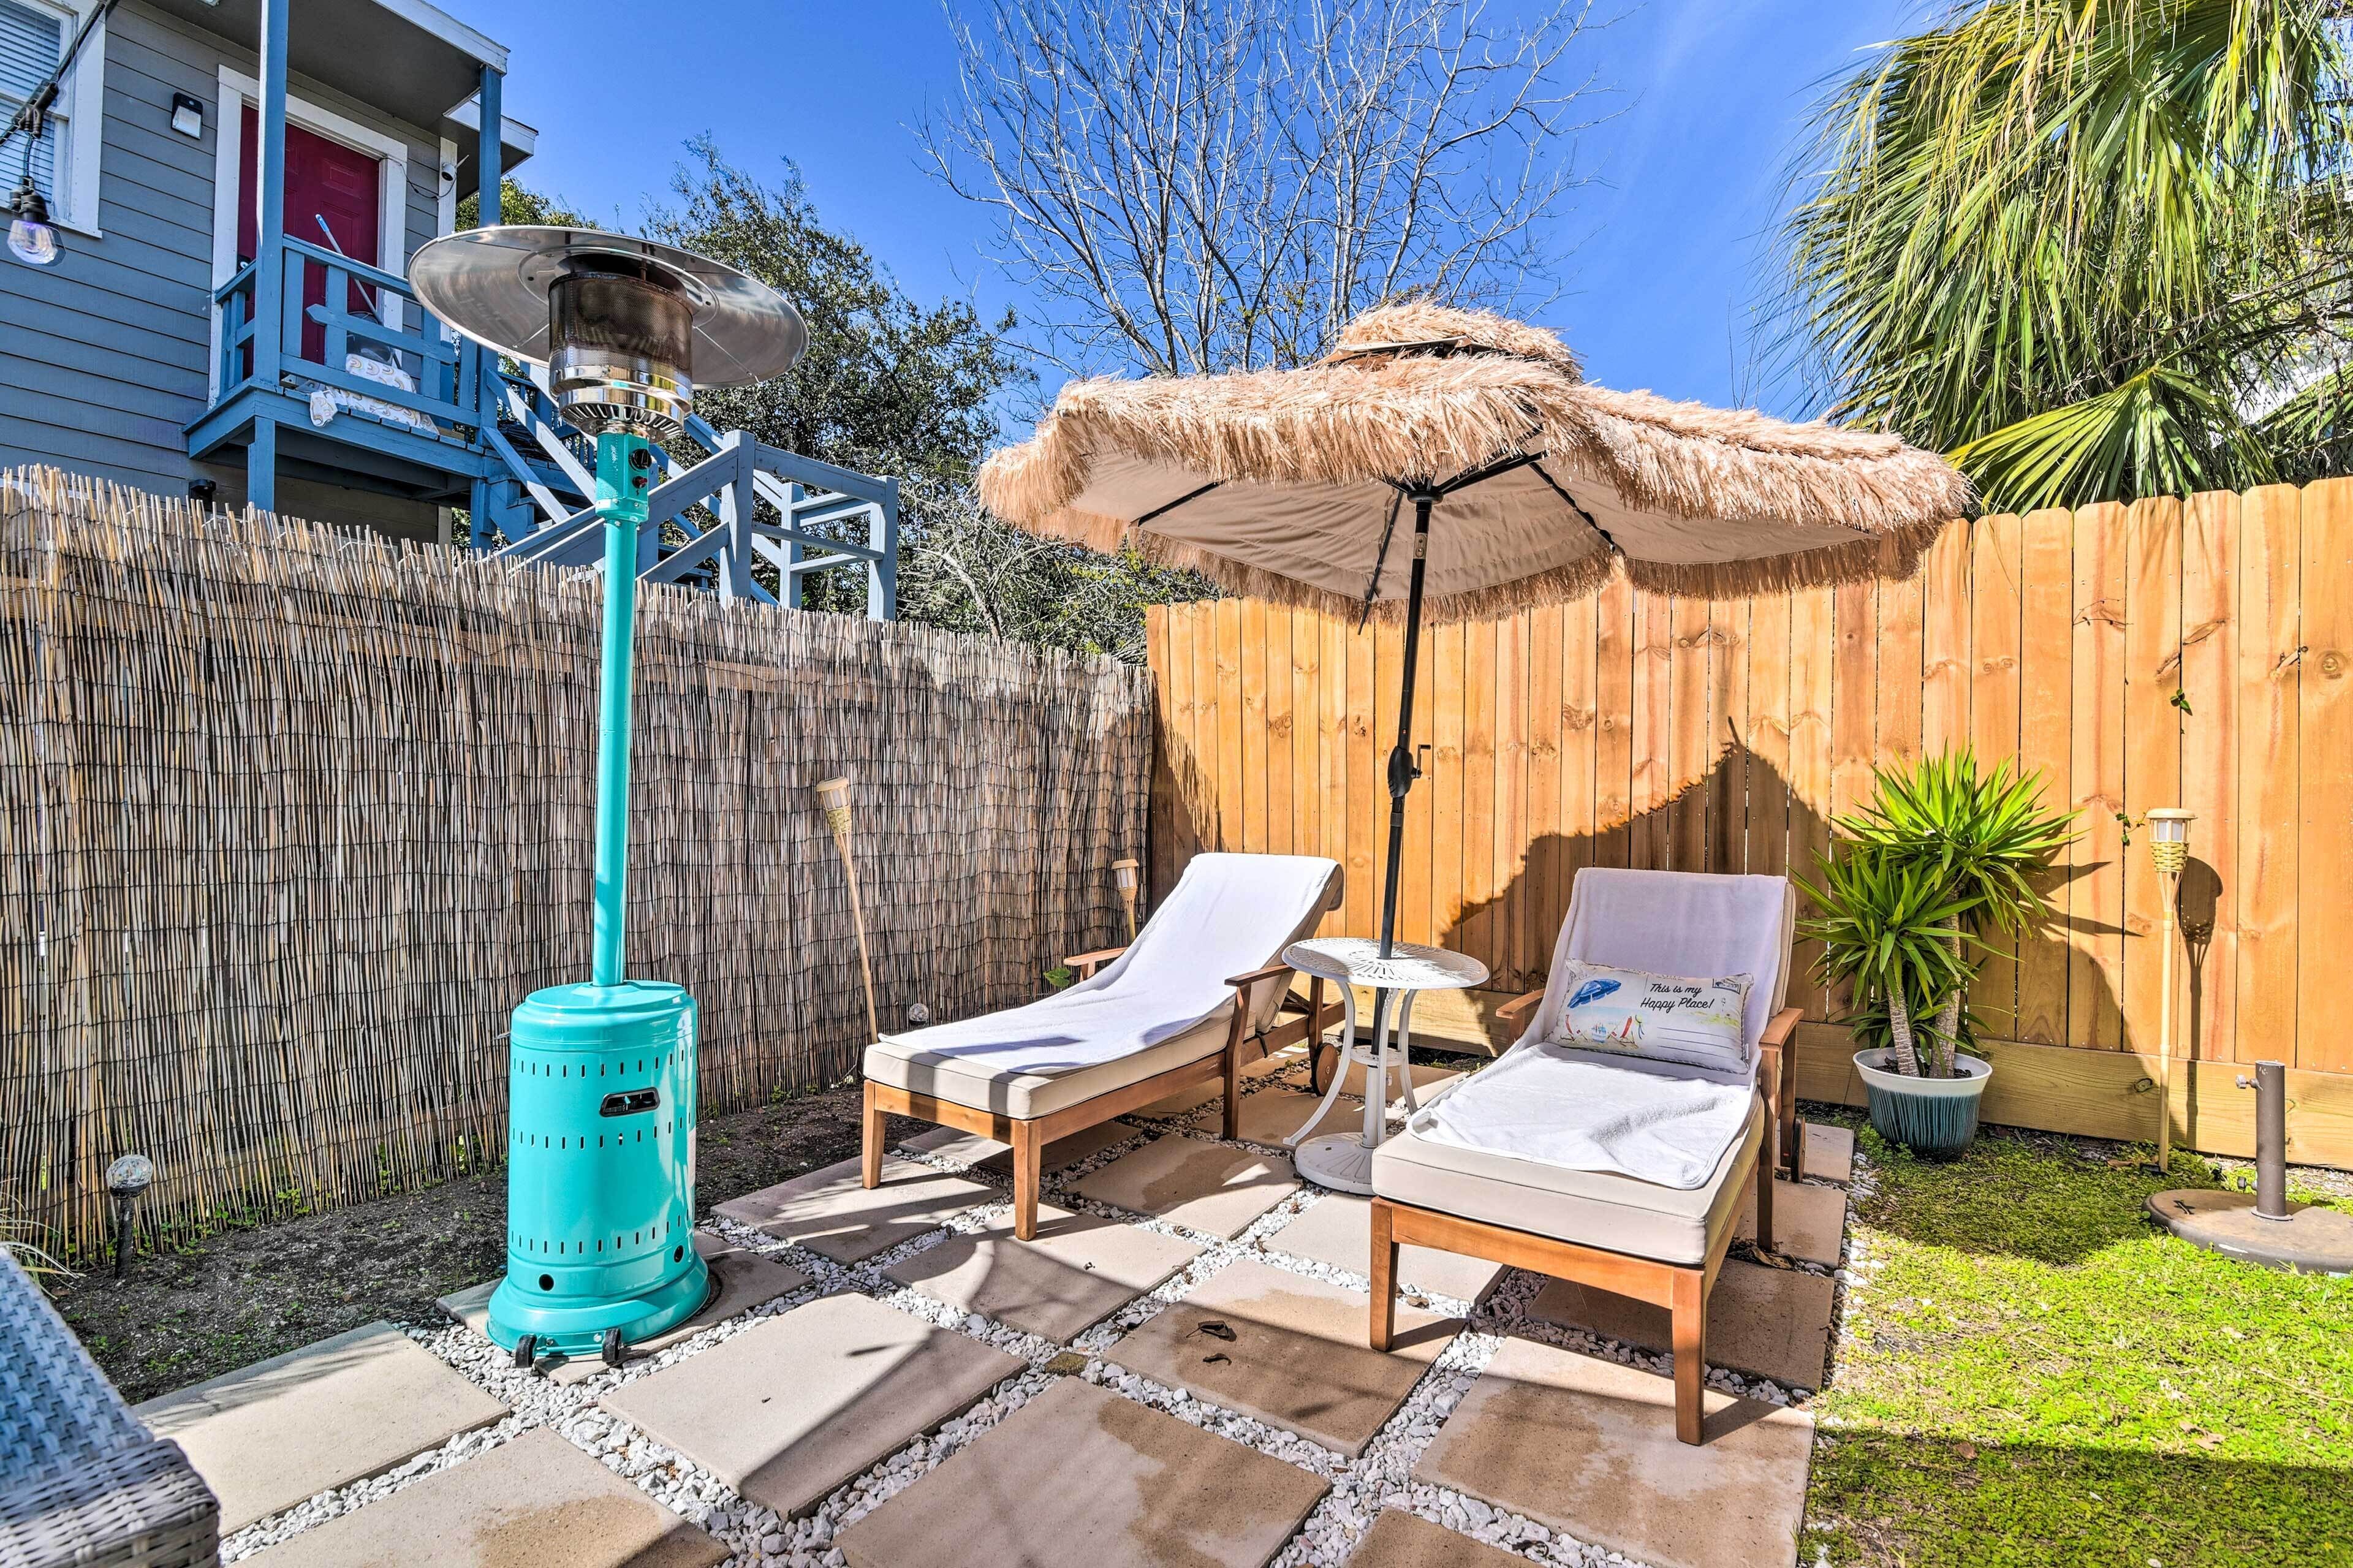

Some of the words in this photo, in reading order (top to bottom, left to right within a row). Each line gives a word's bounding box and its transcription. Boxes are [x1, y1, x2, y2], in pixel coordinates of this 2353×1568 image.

[1650, 983, 1670, 993] This
[1684, 987, 1702, 998] my
[1640, 998, 1675, 1013] Happy
[1678, 997, 1715, 1009] Place!
